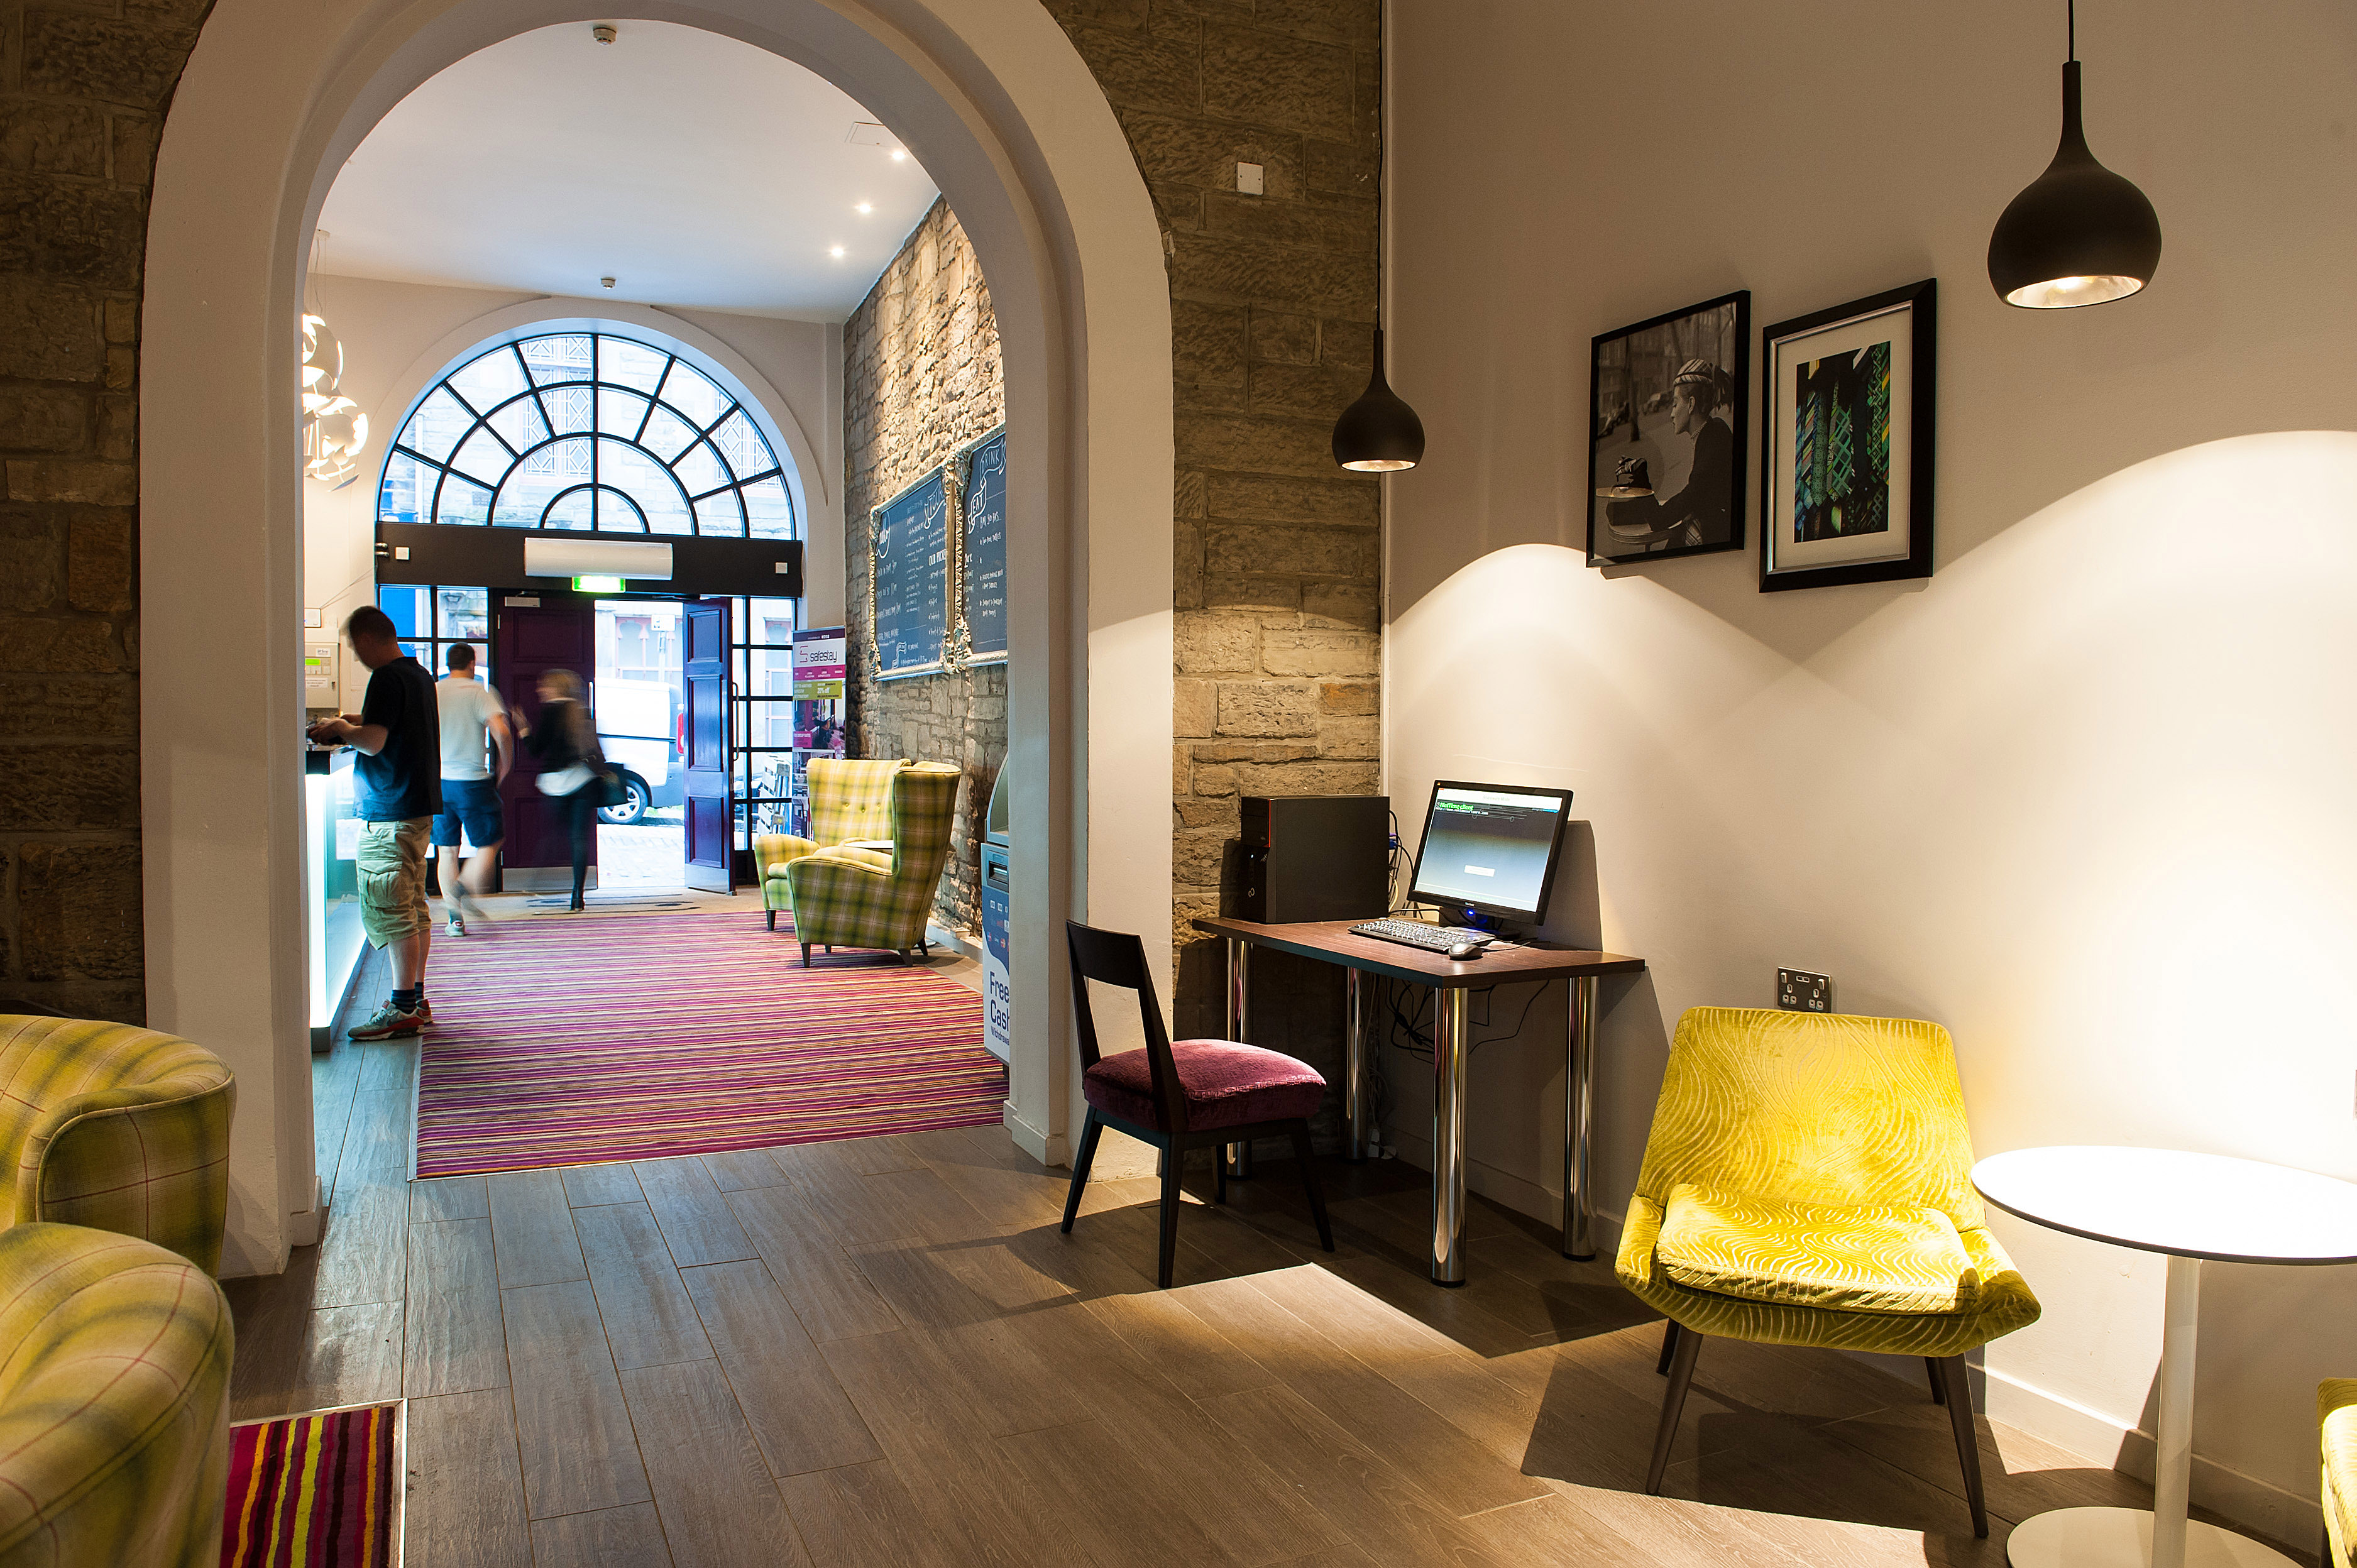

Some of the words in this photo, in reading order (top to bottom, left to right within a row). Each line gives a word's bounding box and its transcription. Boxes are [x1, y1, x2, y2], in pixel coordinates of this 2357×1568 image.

[982, 449, 999, 474] DRINK
[973, 493, 984, 514] EAT
[810, 649, 837, 663] safestay
[990, 971, 1009, 1004] Free
[991, 1025, 1009, 1046] Withdrawa
